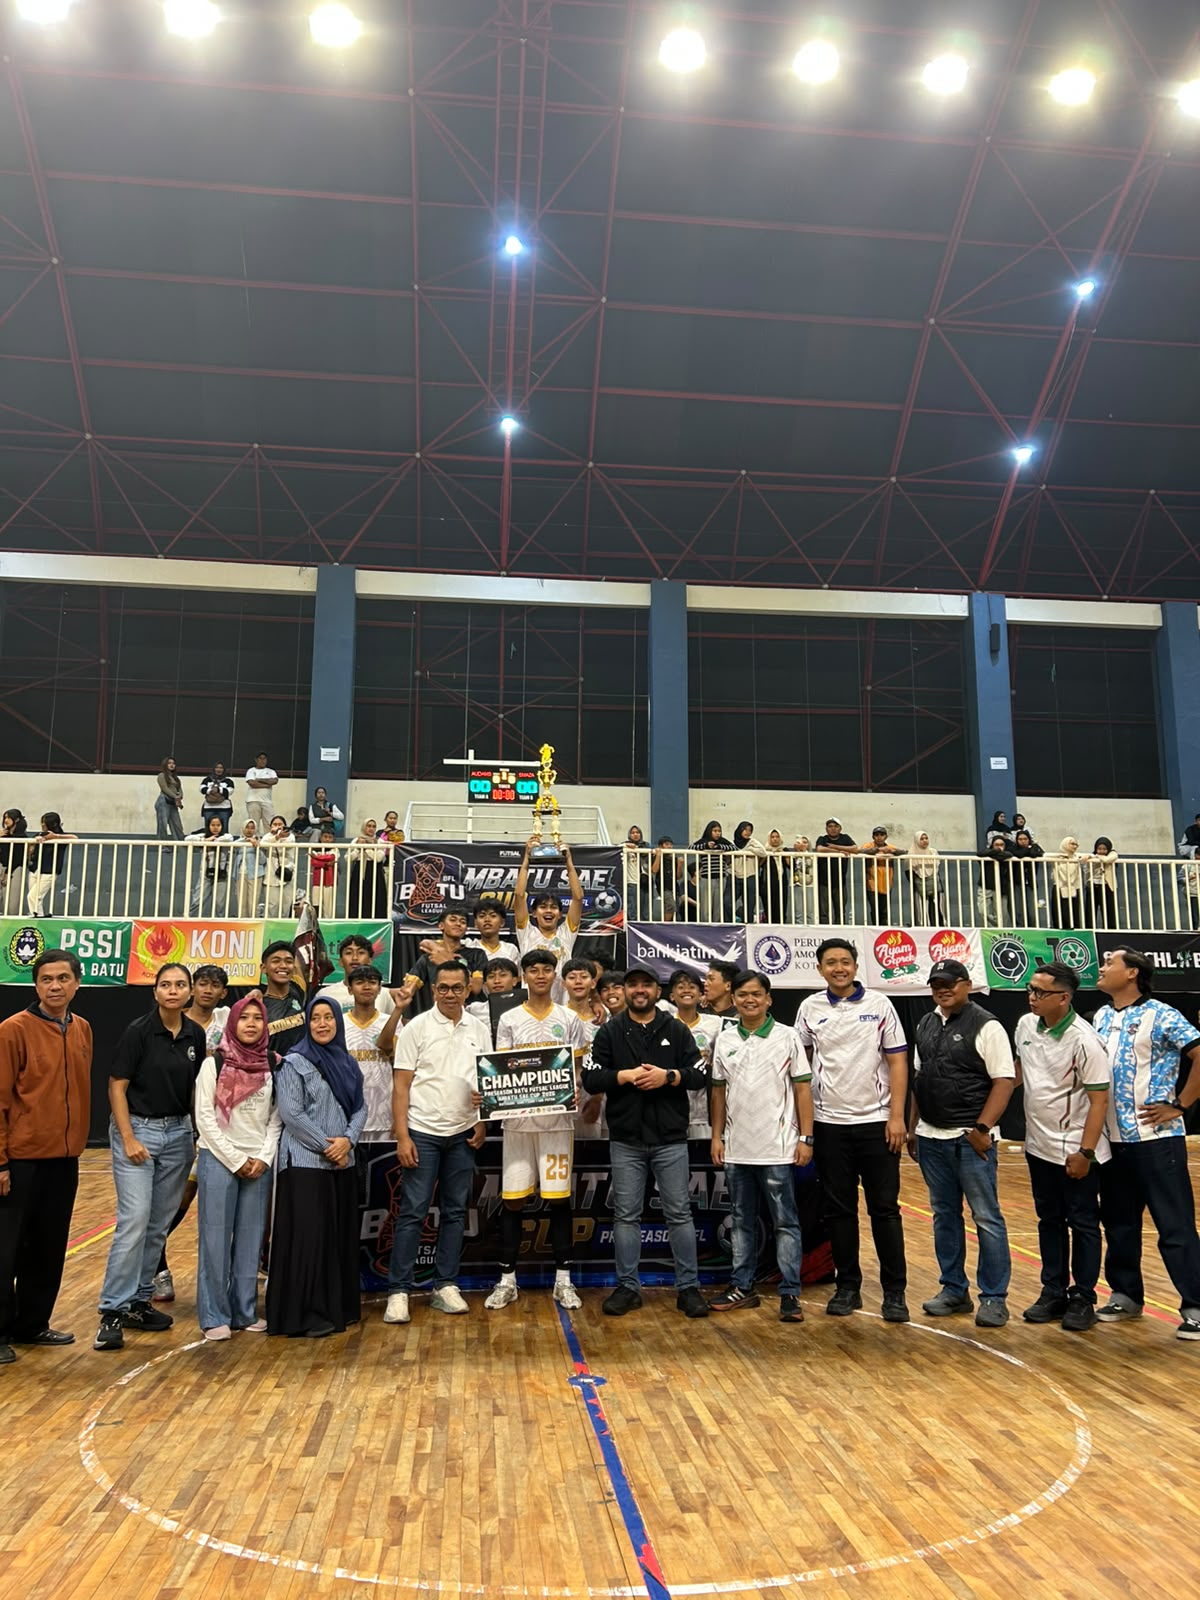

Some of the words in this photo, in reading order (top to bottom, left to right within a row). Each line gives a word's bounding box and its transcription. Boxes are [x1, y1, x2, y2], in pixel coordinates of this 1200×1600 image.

[558, 869, 609, 891] SAE
[60, 929, 122, 959] PSSI
[190, 929, 256, 959] KONI
[876, 944, 912, 958] Ayam
[930, 944, 965, 958] Ayam
[638, 943, 718, 962] bankjatim
[794, 950, 816, 958] AMO
[794, 962, 816, 970] KOT
[882, 954, 914, 967] Geprek
[91, 963, 124, 976] BATU
[224, 964, 256, 977] BATU
[482, 1068, 570, 1090] CHAMPIONS
[484, 1088, 513, 1096] PRESEASON
[546, 1154, 568, 1180] 25
